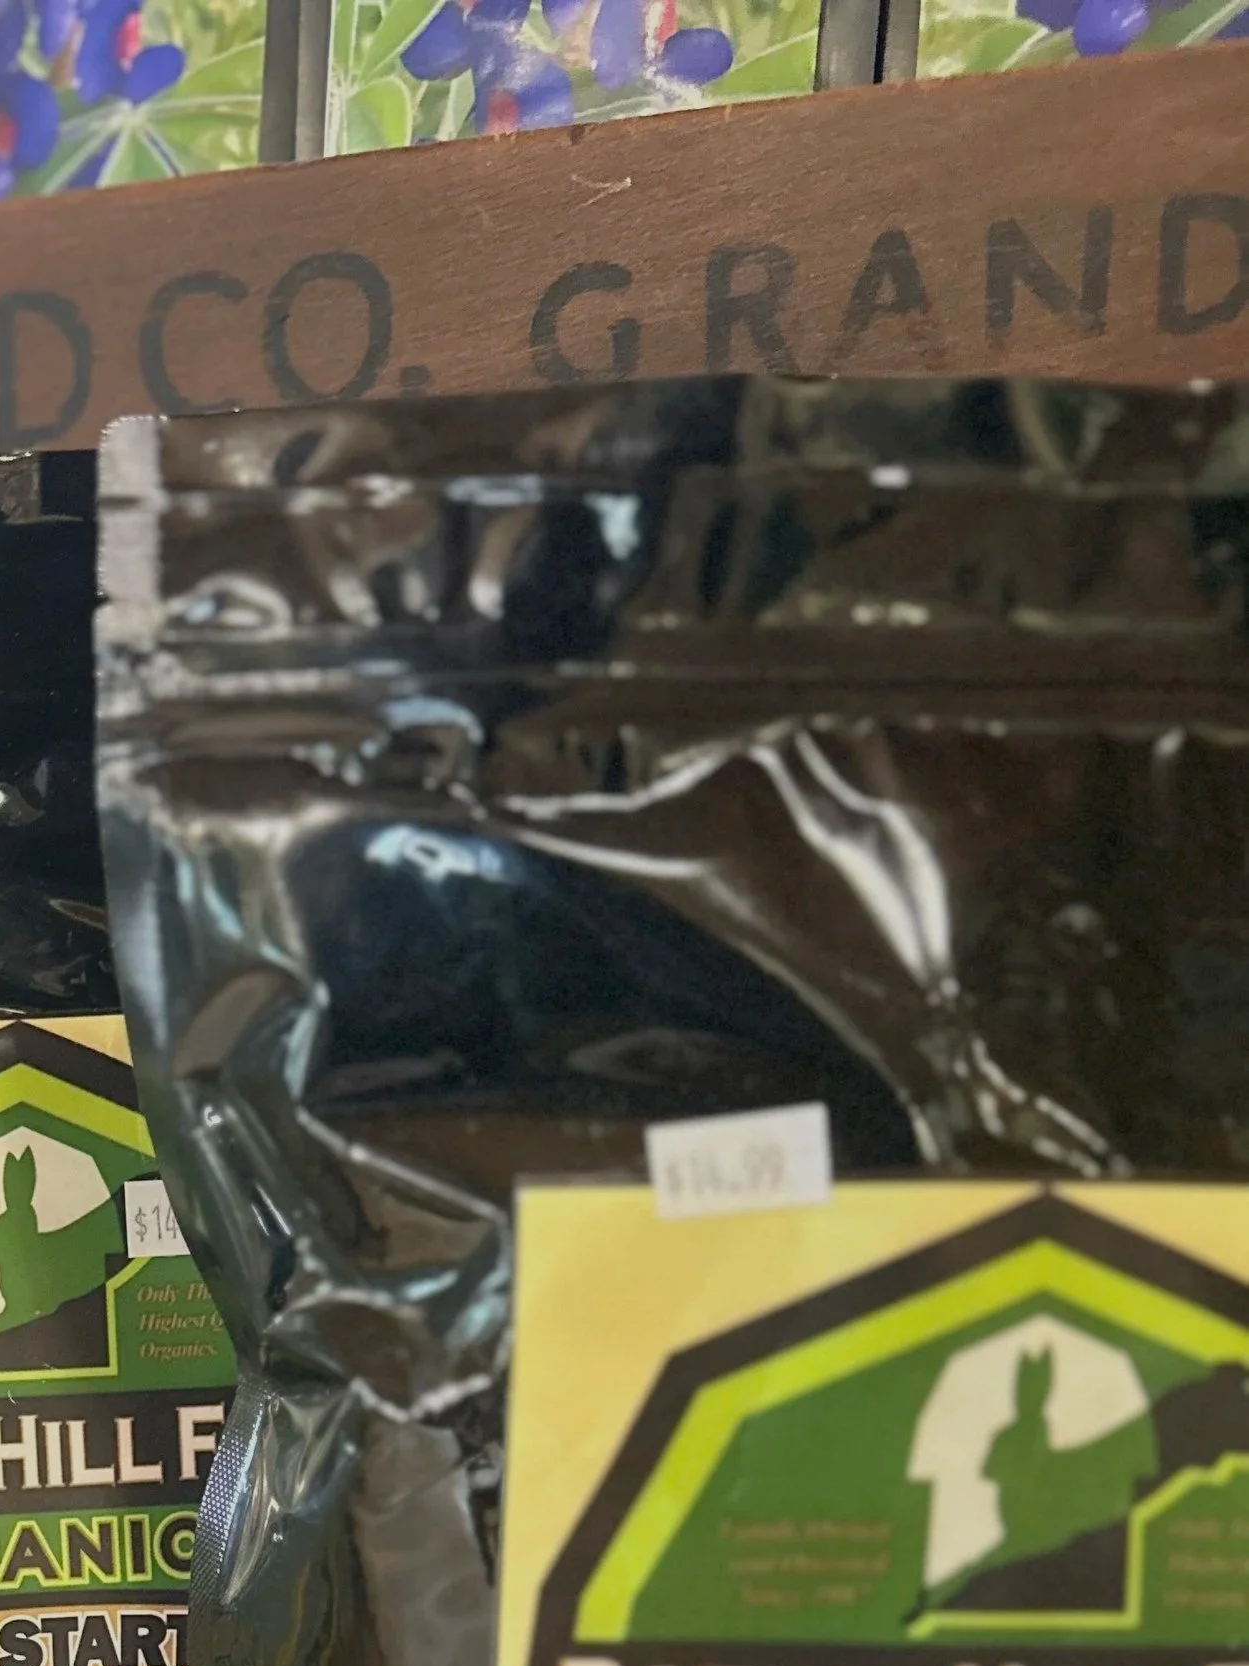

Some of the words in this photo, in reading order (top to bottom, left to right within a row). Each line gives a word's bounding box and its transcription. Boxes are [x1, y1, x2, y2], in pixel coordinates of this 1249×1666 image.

[136, 251, 431, 413] CO.
[529, 193, 1249, 381] GRAND
[134, 1205, 179, 1242] $14
[137, 1284, 179, 1306] Only
[187, 1282, 211, 1300] Th
[139, 1312, 206, 1333] Highest
